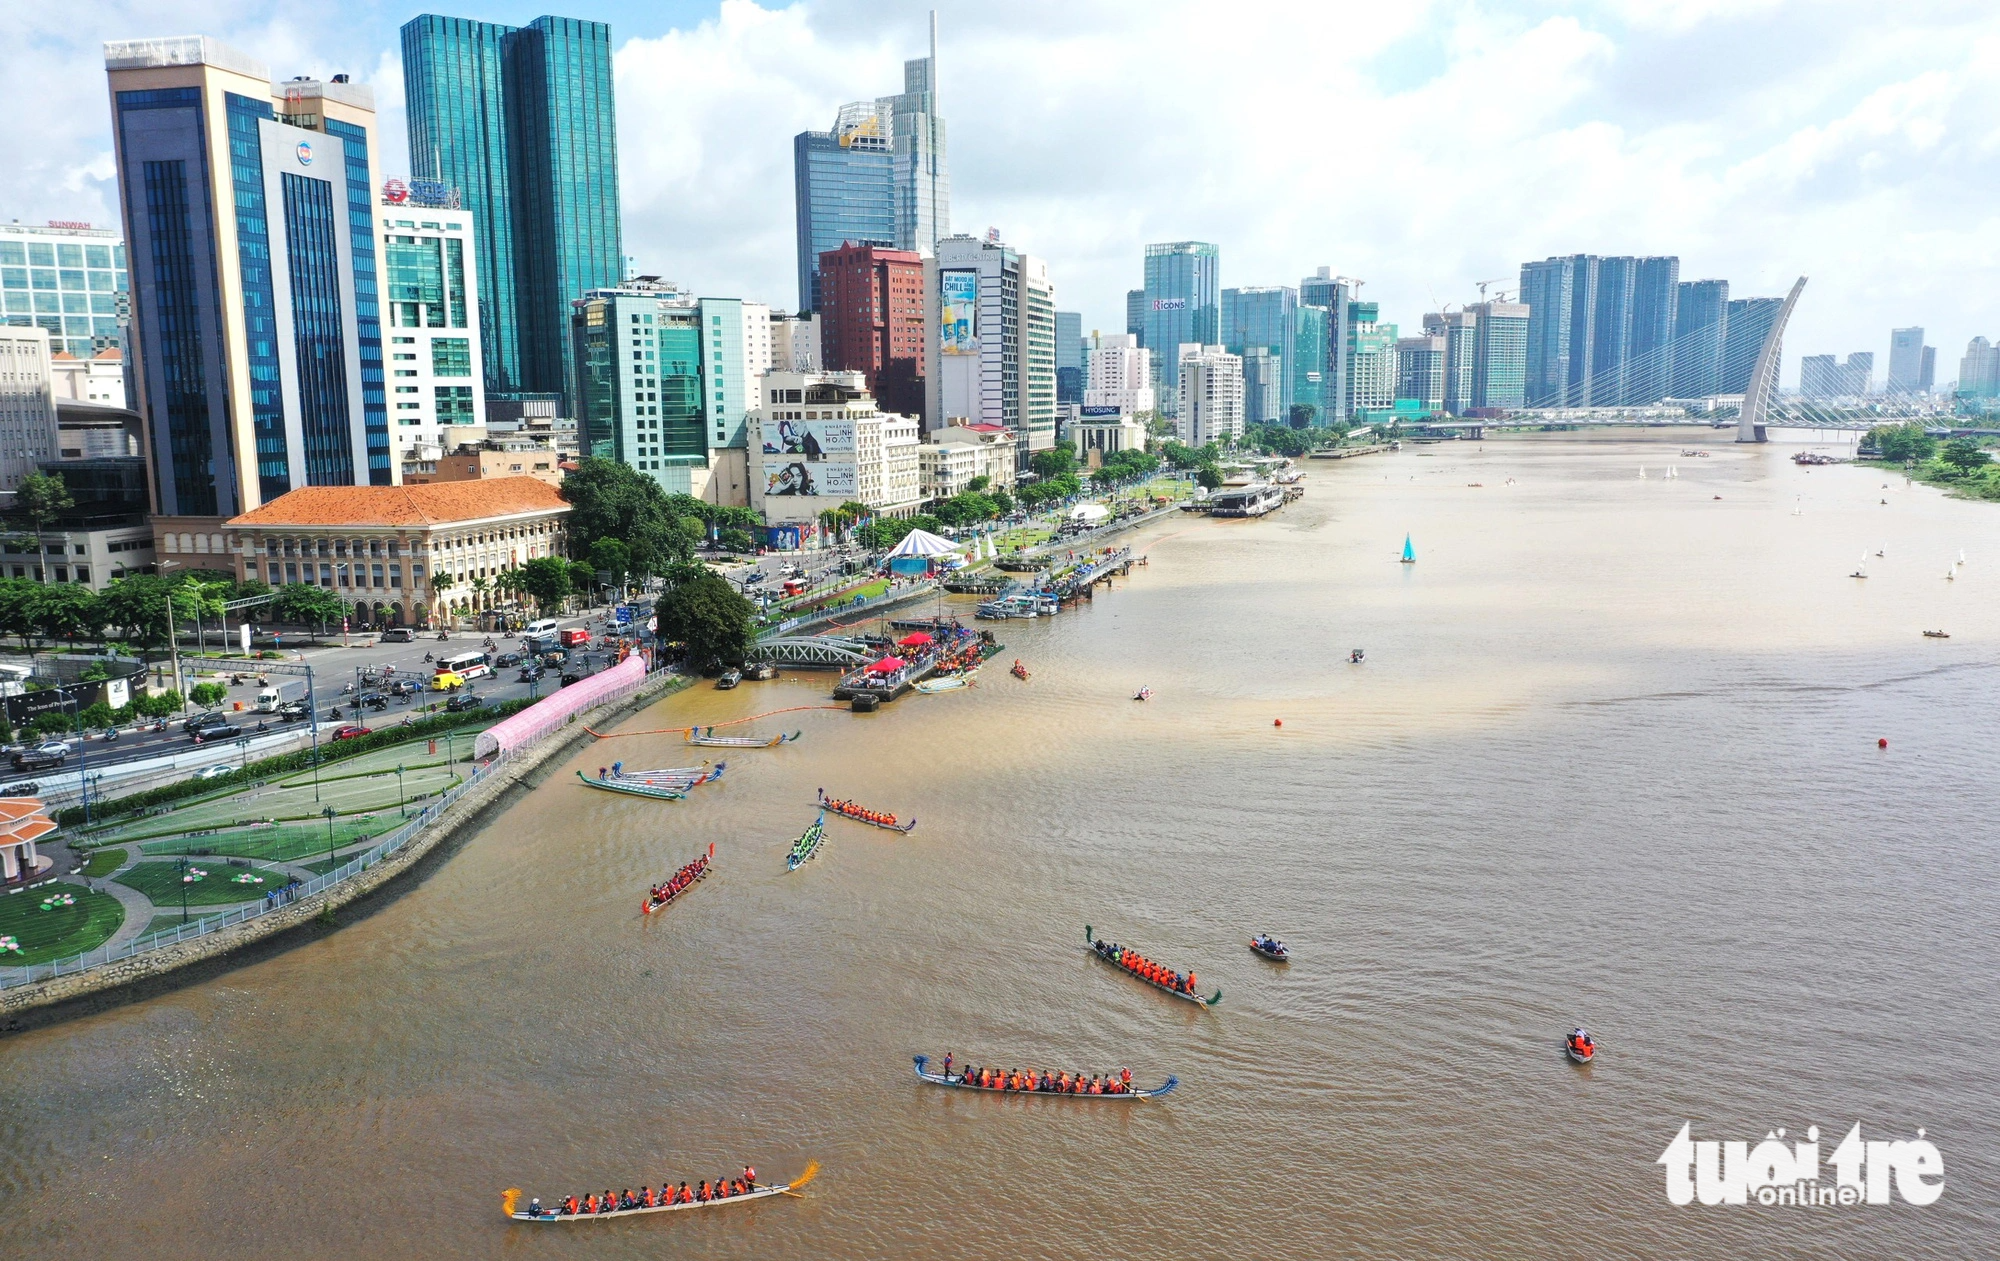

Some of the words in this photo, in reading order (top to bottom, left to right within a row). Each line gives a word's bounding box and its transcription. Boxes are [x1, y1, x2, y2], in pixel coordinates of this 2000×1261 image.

[48, 219, 91, 230] SUNWAH
[942, 253, 967, 262] LIBERTY
[968, 252, 998, 262] CENTRAL
[944, 282, 963, 292] CHILL
